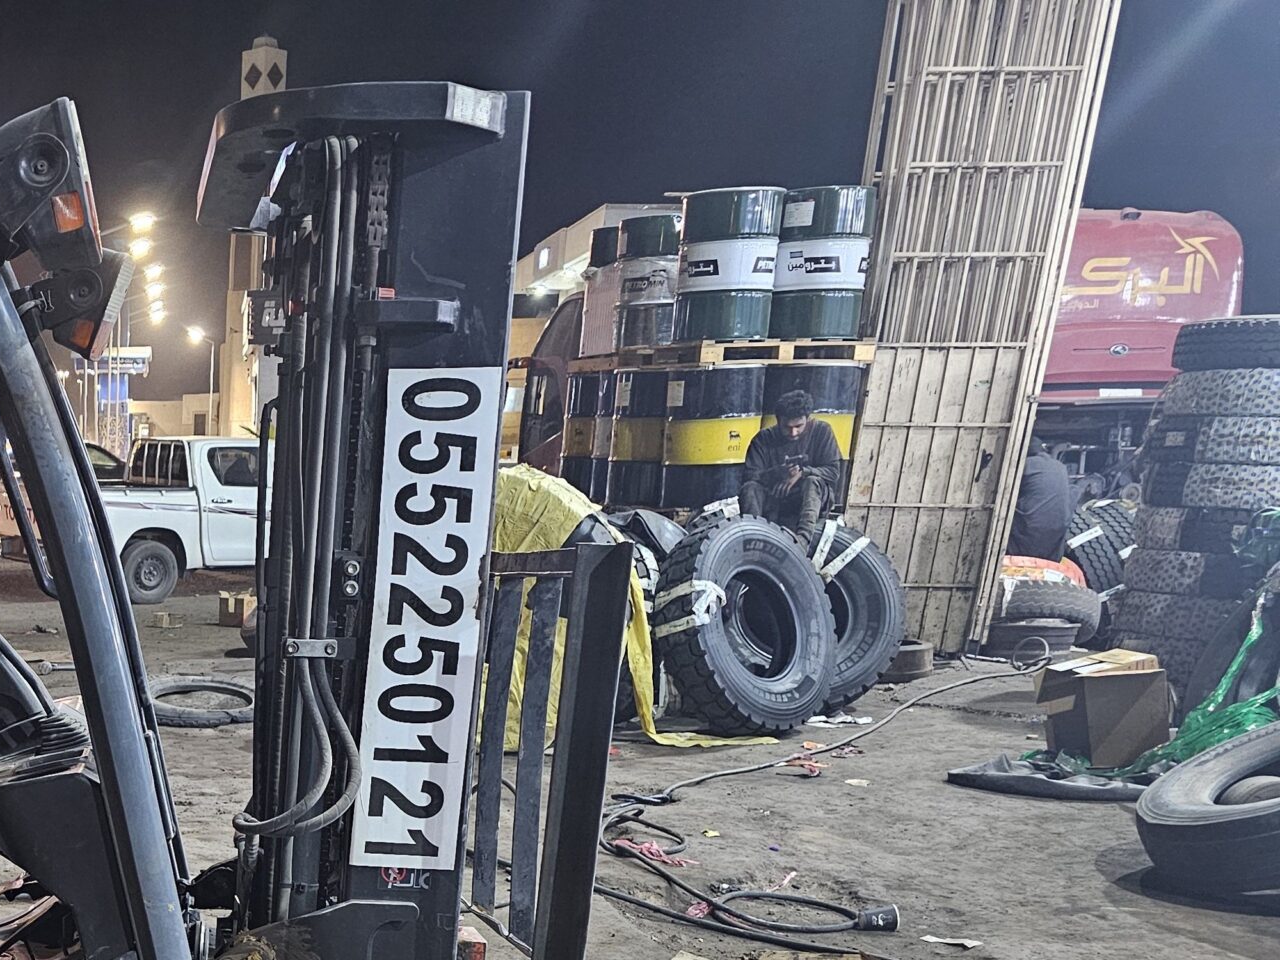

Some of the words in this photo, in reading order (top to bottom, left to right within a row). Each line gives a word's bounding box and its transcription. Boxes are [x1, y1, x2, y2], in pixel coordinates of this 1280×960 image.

[787, 257, 837, 273] بترومين
[1061, 253, 1205, 307] البرك
[727, 441, 742, 452] eni
[364, 377, 482, 858] 0552250121
